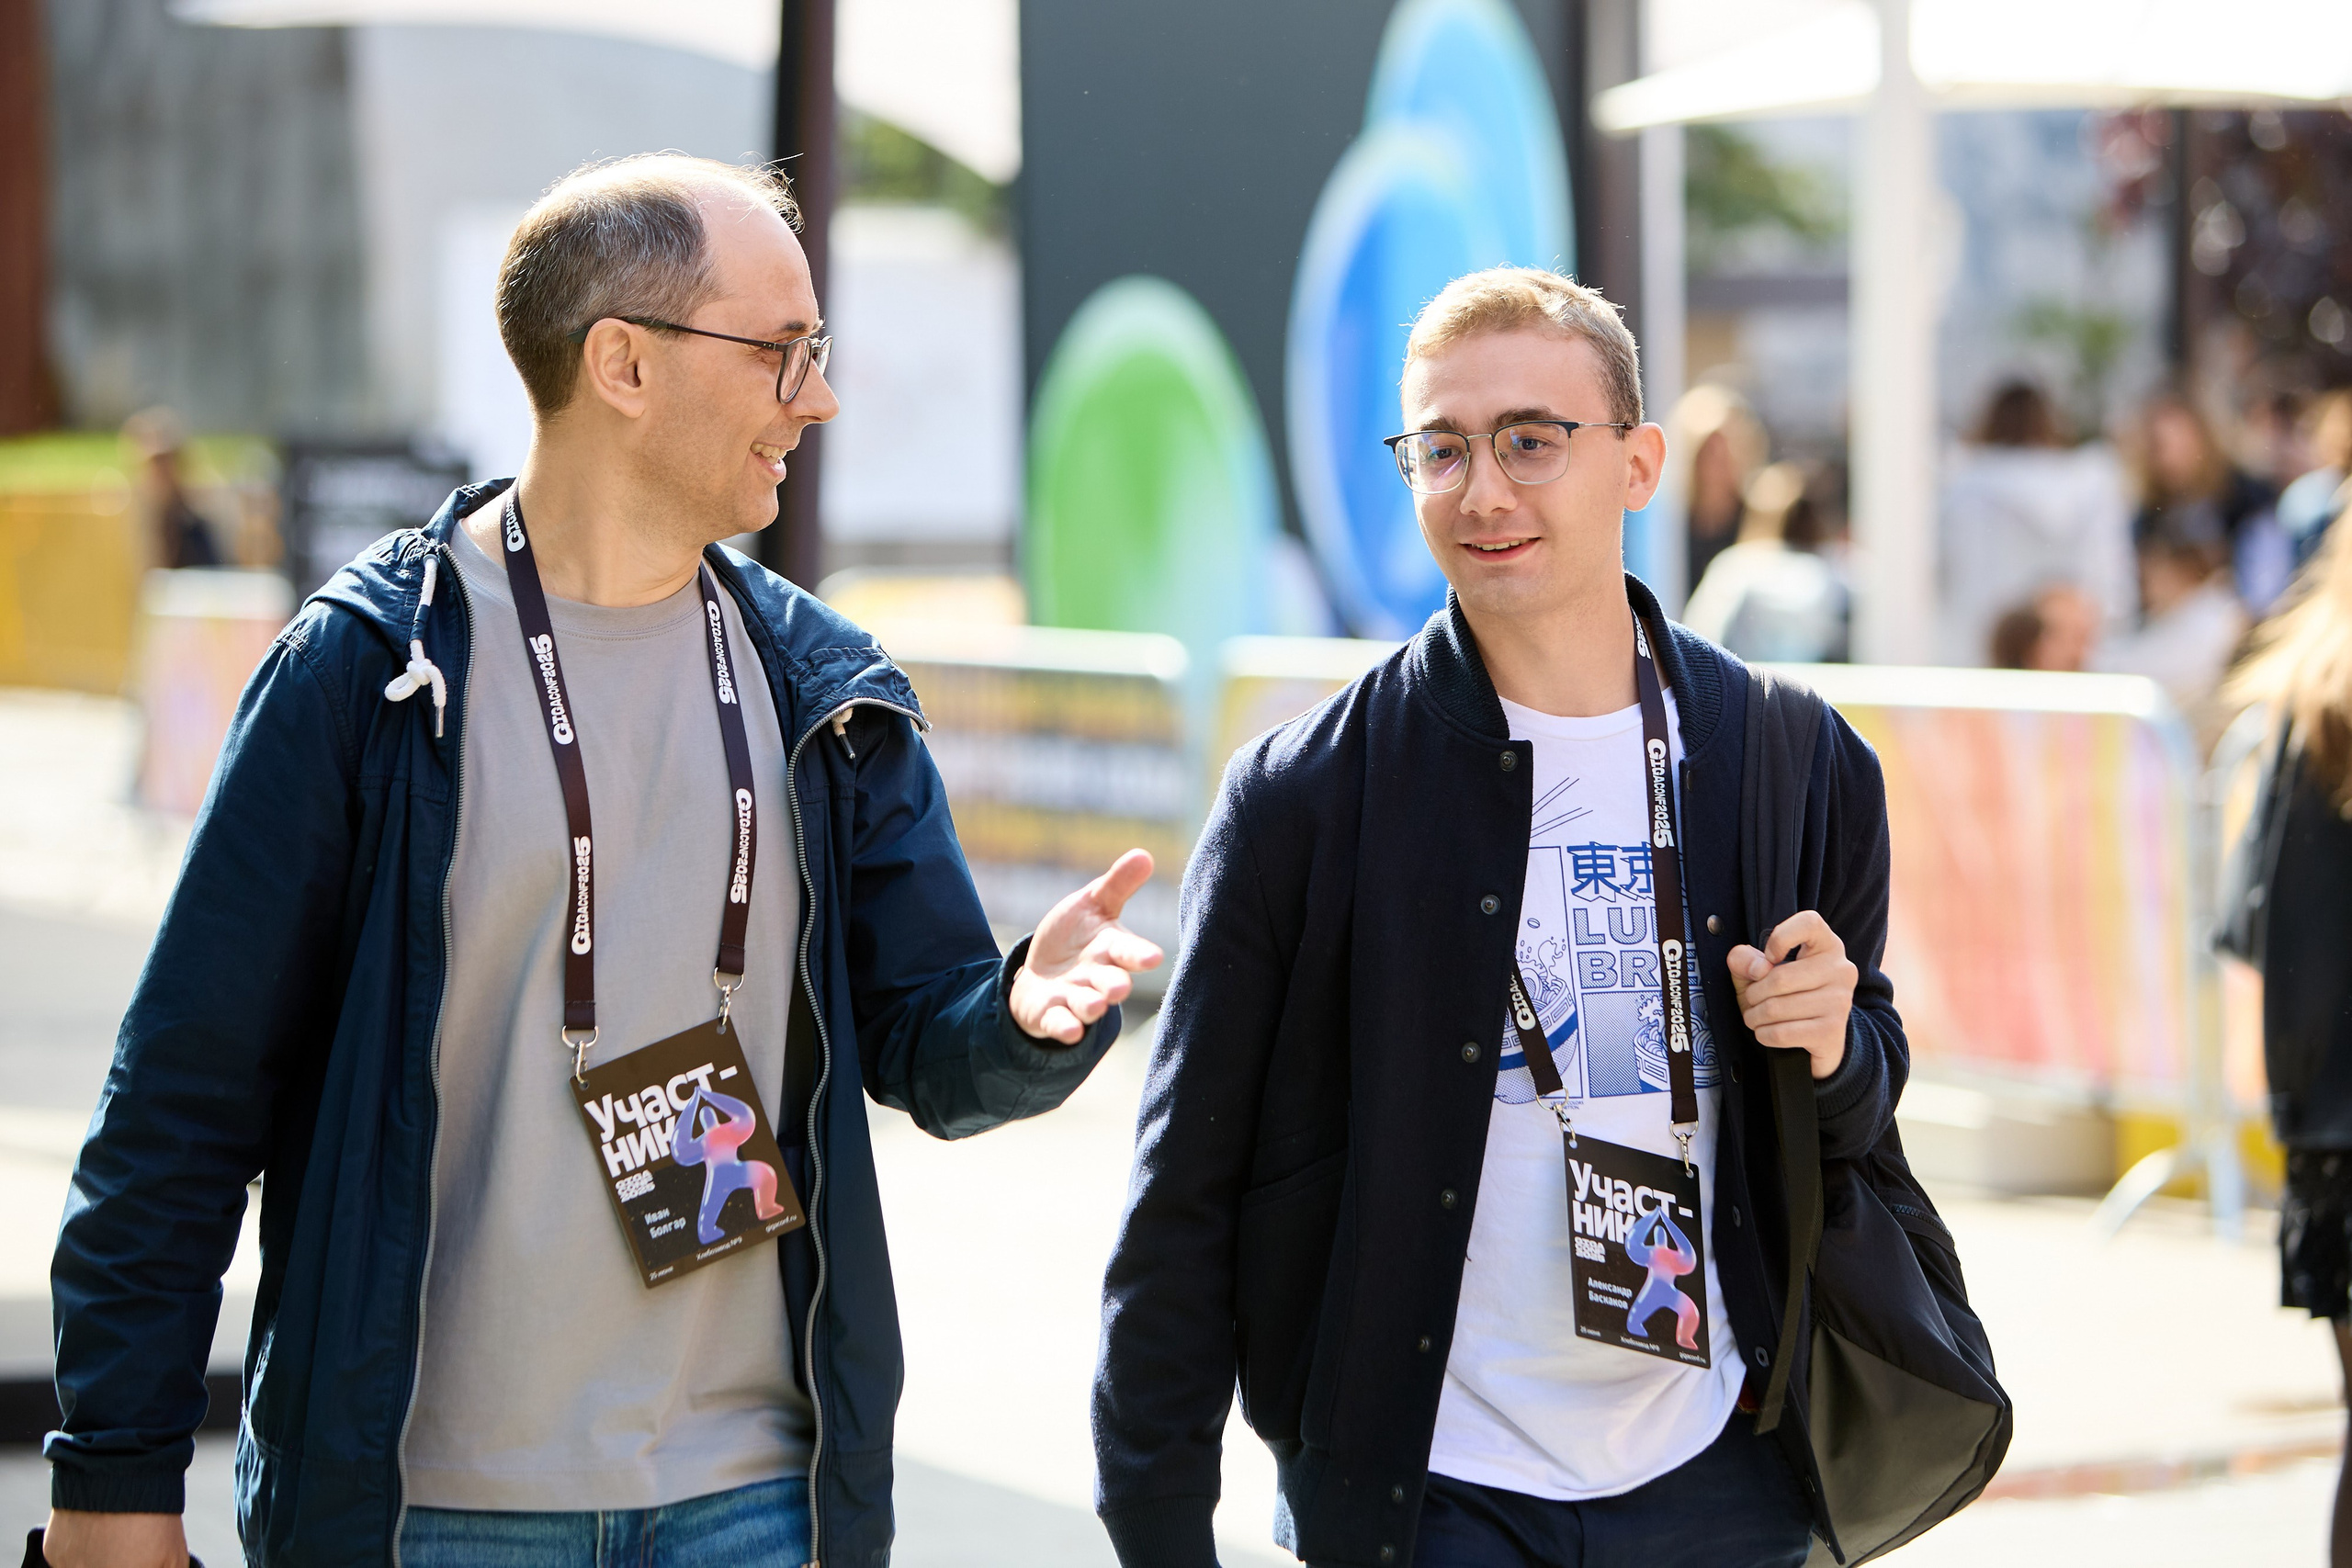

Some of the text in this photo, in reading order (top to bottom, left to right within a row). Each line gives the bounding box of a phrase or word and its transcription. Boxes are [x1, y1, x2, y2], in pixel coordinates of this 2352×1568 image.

[528, 633, 575, 746] GIGACONF2025
[707, 599, 738, 705] GIGACONF2025
[729, 787, 752, 905] GIGACONF2025
[1646, 738, 1675, 849] GIGACONF2025
[571, 835, 592, 955] GIGACONF2025
[1661, 938, 1690, 1054] GIGACONF2025
[644, 1207, 671, 1225] Иван
[649, 1216, 687, 1240] Болгар
[1587, 1276, 1633, 1300] Александр
[1588, 1290, 1629, 1311] Баскаков
